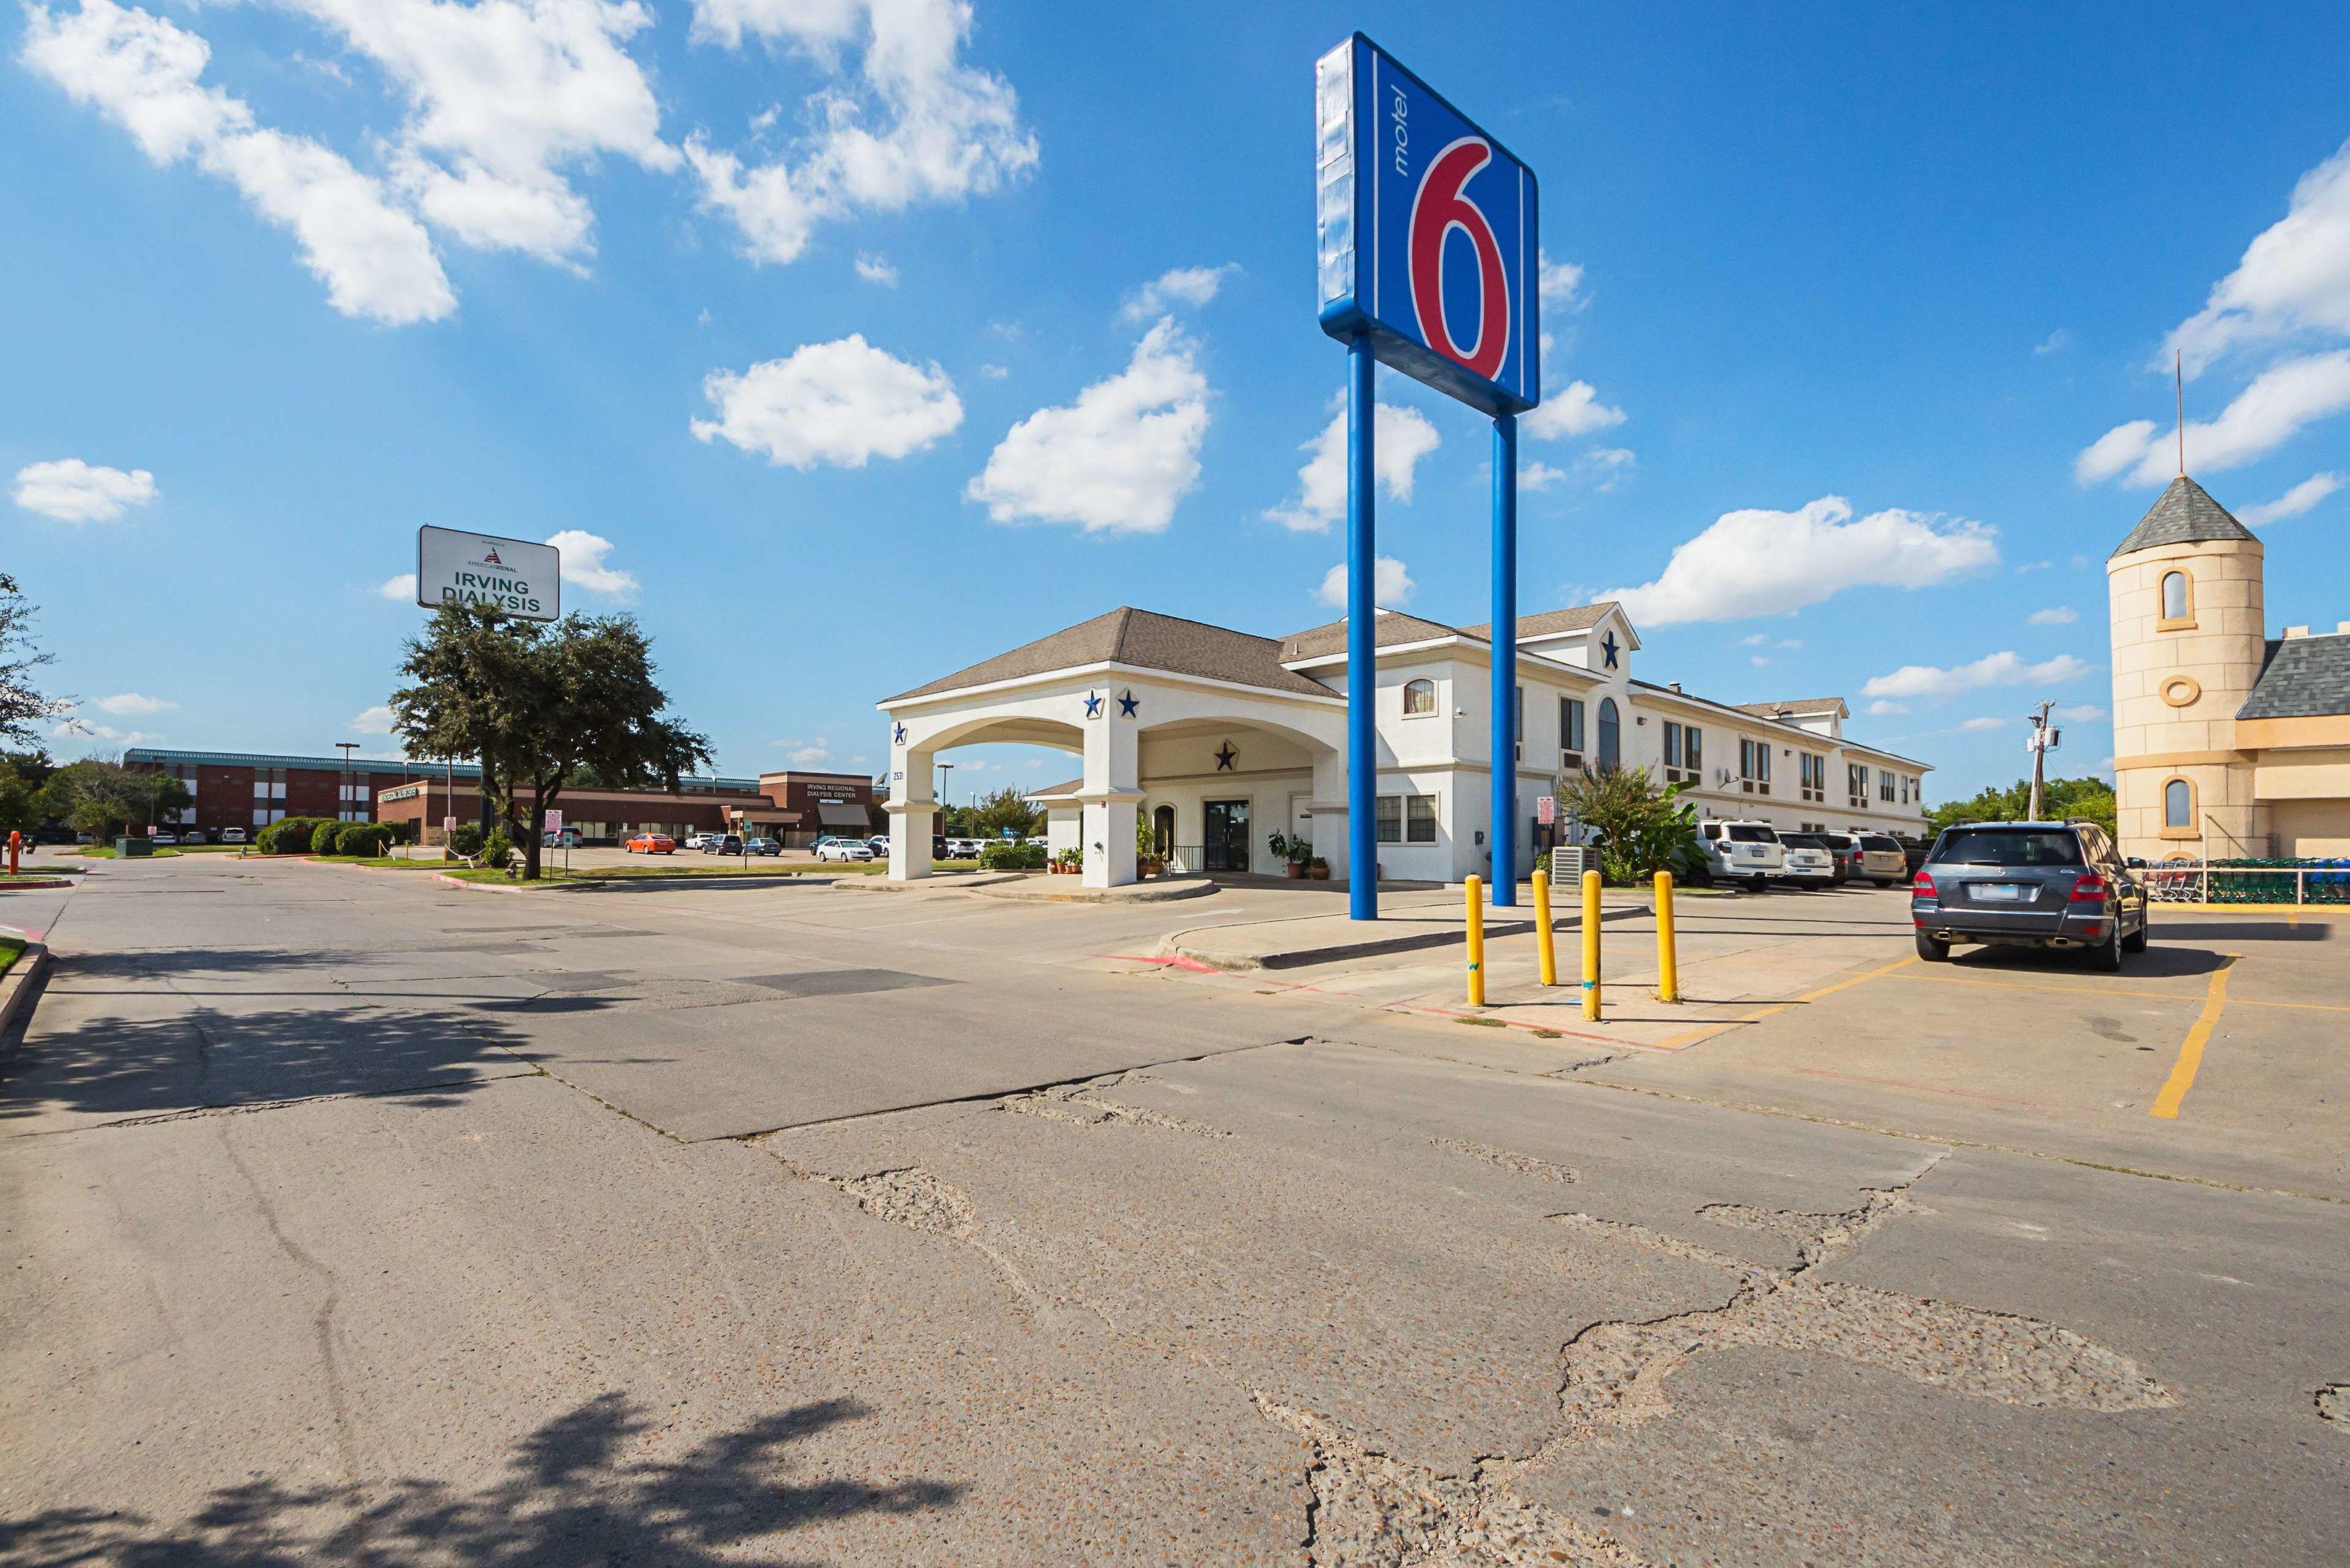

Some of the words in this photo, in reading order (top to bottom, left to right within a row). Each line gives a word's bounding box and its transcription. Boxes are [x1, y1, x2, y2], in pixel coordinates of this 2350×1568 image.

[1391, 85, 1408, 177] motel
[1408, 136, 1511, 382] 6
[455, 571, 529, 595] IRVING
